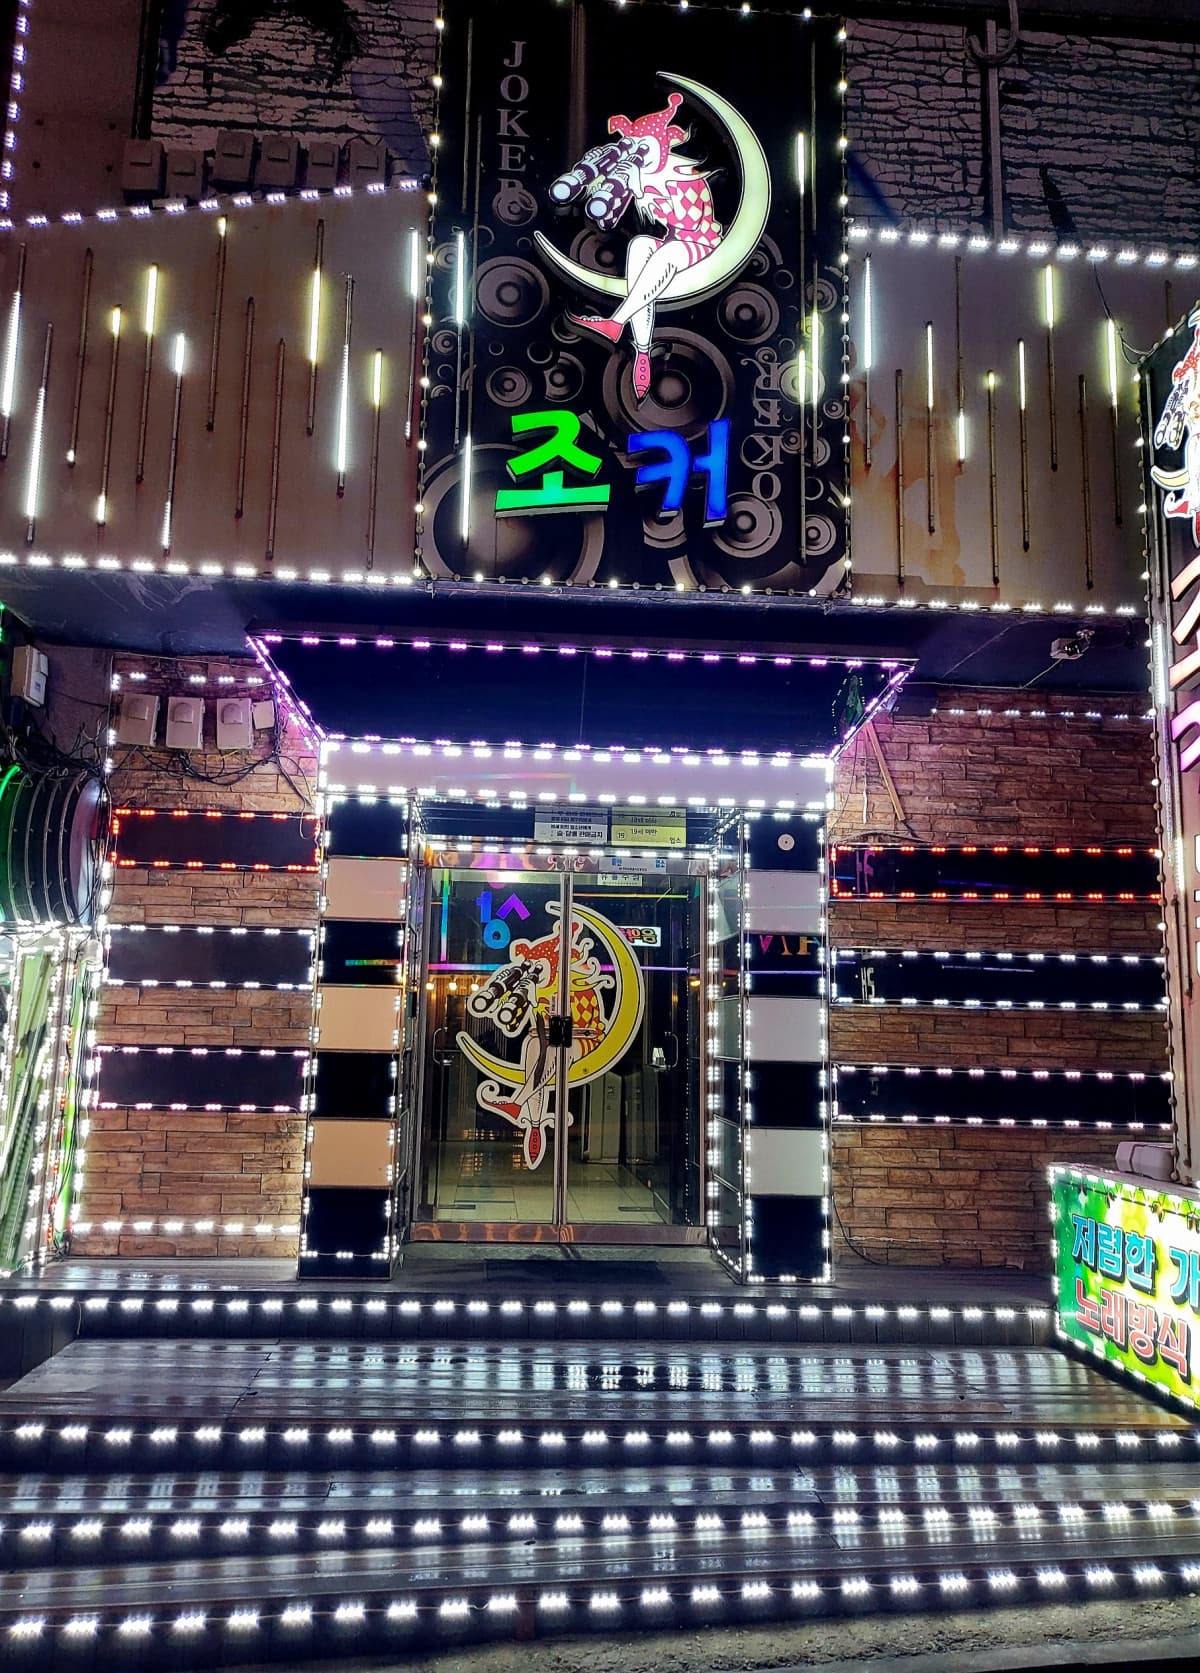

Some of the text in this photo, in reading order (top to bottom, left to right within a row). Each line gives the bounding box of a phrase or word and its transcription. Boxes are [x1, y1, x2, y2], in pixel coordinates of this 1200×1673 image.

[494, 409, 731, 525] 조커
[1071, 1214, 1156, 1291] 저렴한
[1075, 1277, 1190, 1379] 노래방식
